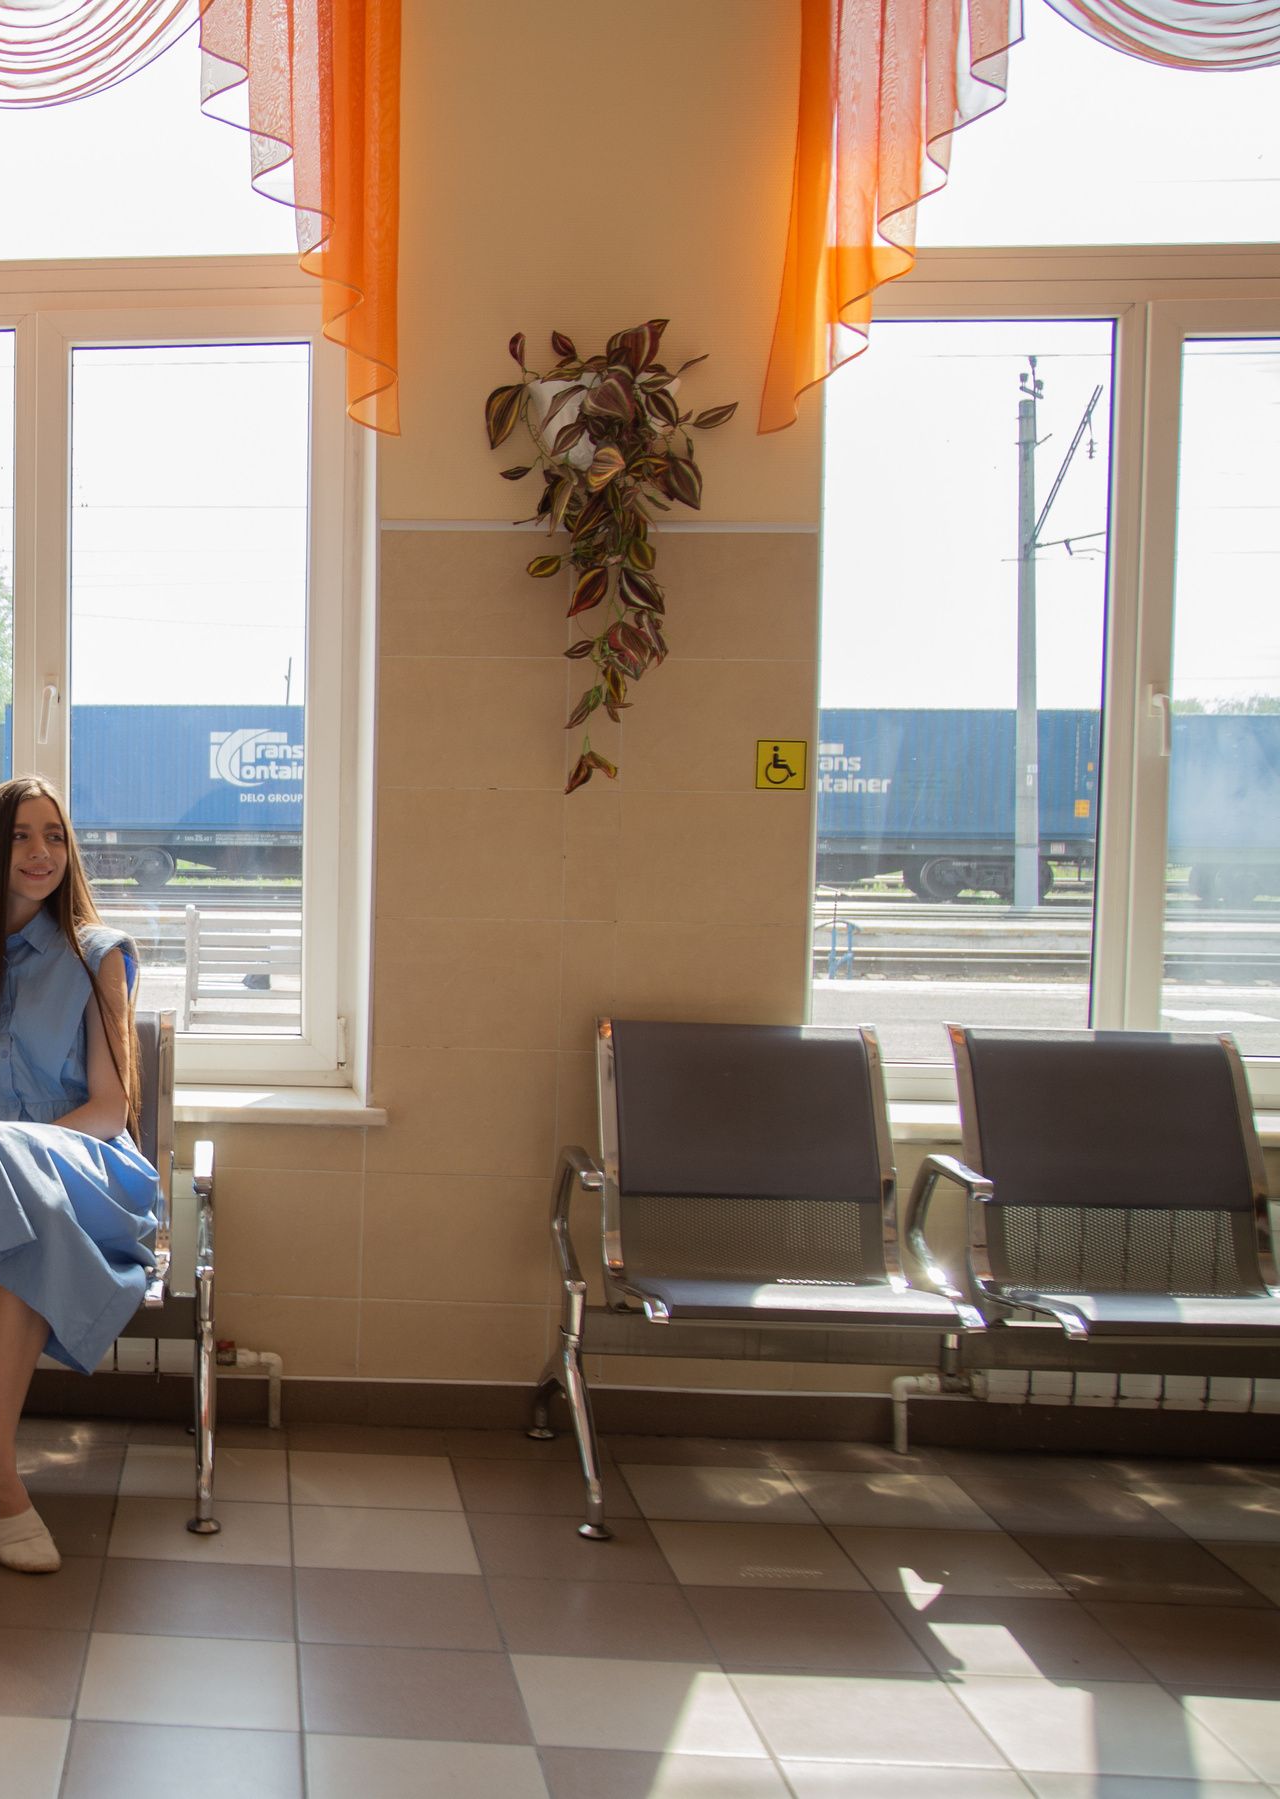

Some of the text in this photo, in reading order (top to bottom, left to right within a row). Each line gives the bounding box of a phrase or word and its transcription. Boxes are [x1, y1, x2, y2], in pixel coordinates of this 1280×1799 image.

[818, 773, 892, 793] tainer
[240, 793, 303, 803] DELO GROUP
